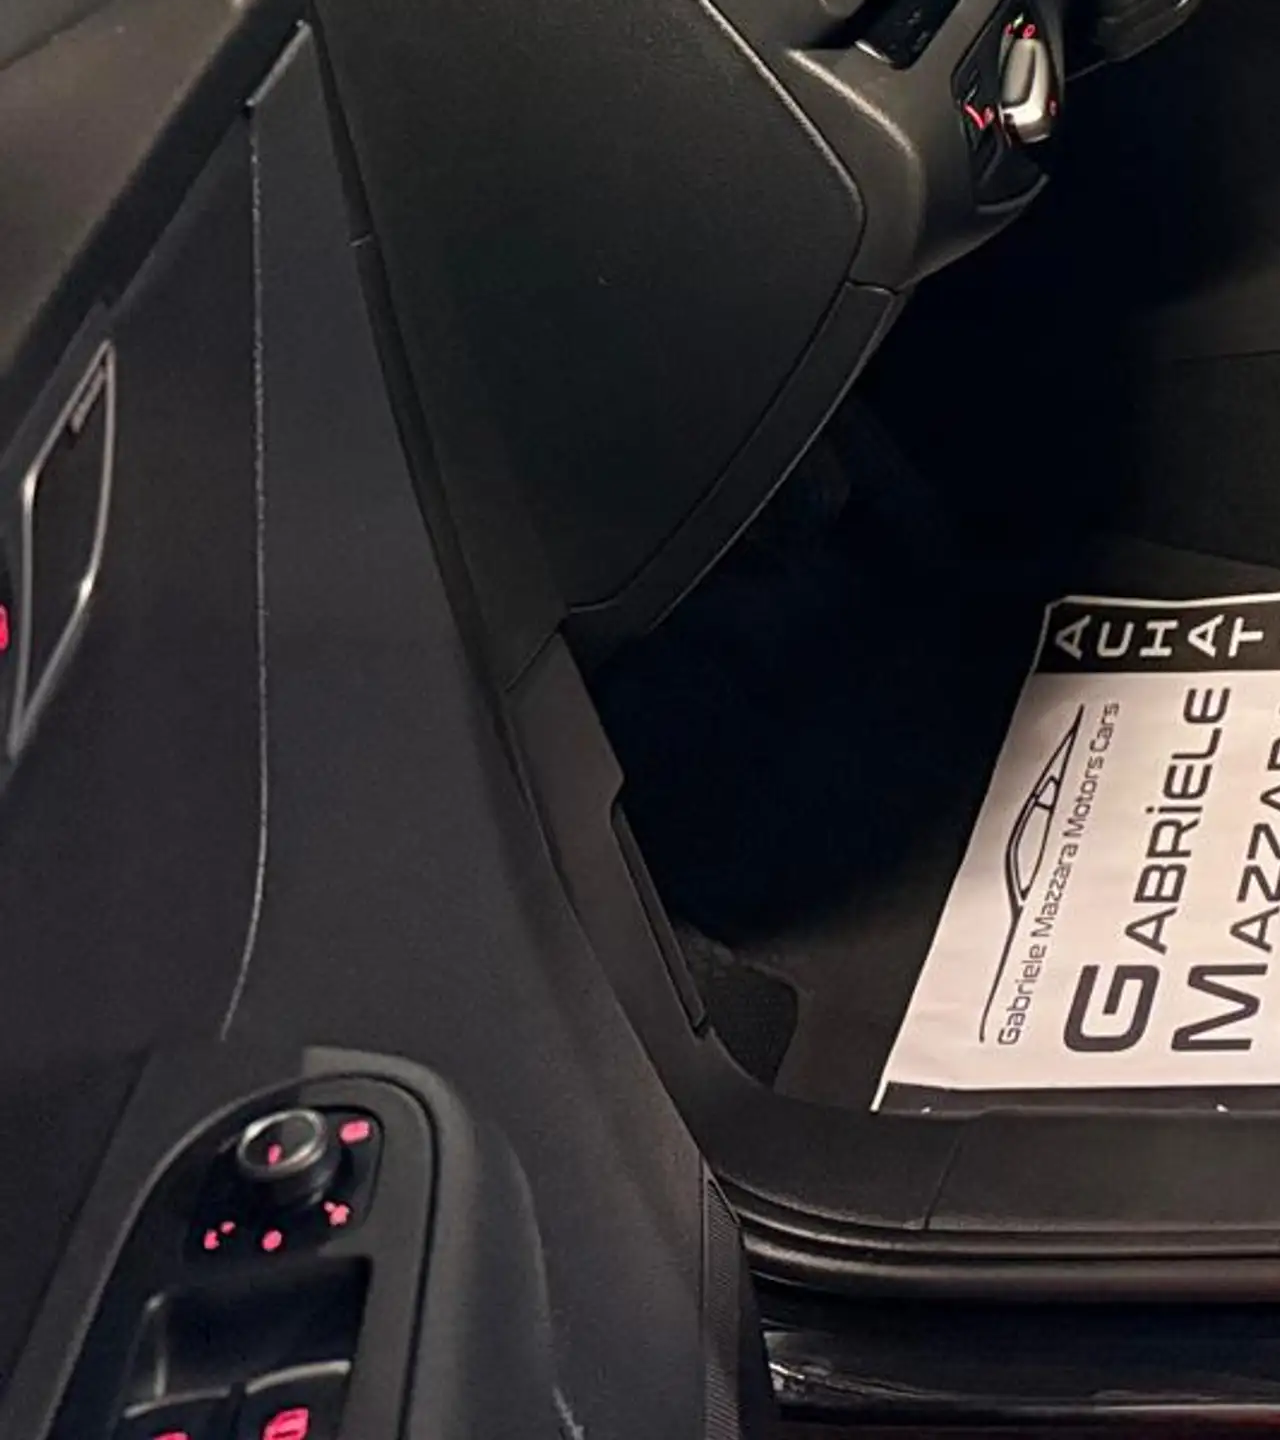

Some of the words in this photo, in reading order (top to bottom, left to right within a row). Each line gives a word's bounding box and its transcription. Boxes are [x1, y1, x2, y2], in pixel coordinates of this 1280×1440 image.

[998, 944, 1047, 1045] Gabriele
[1030, 843, 1079, 938] Mazzara
[1063, 756, 1105, 837] Motors
[1090, 702, 1120, 752] Cars
